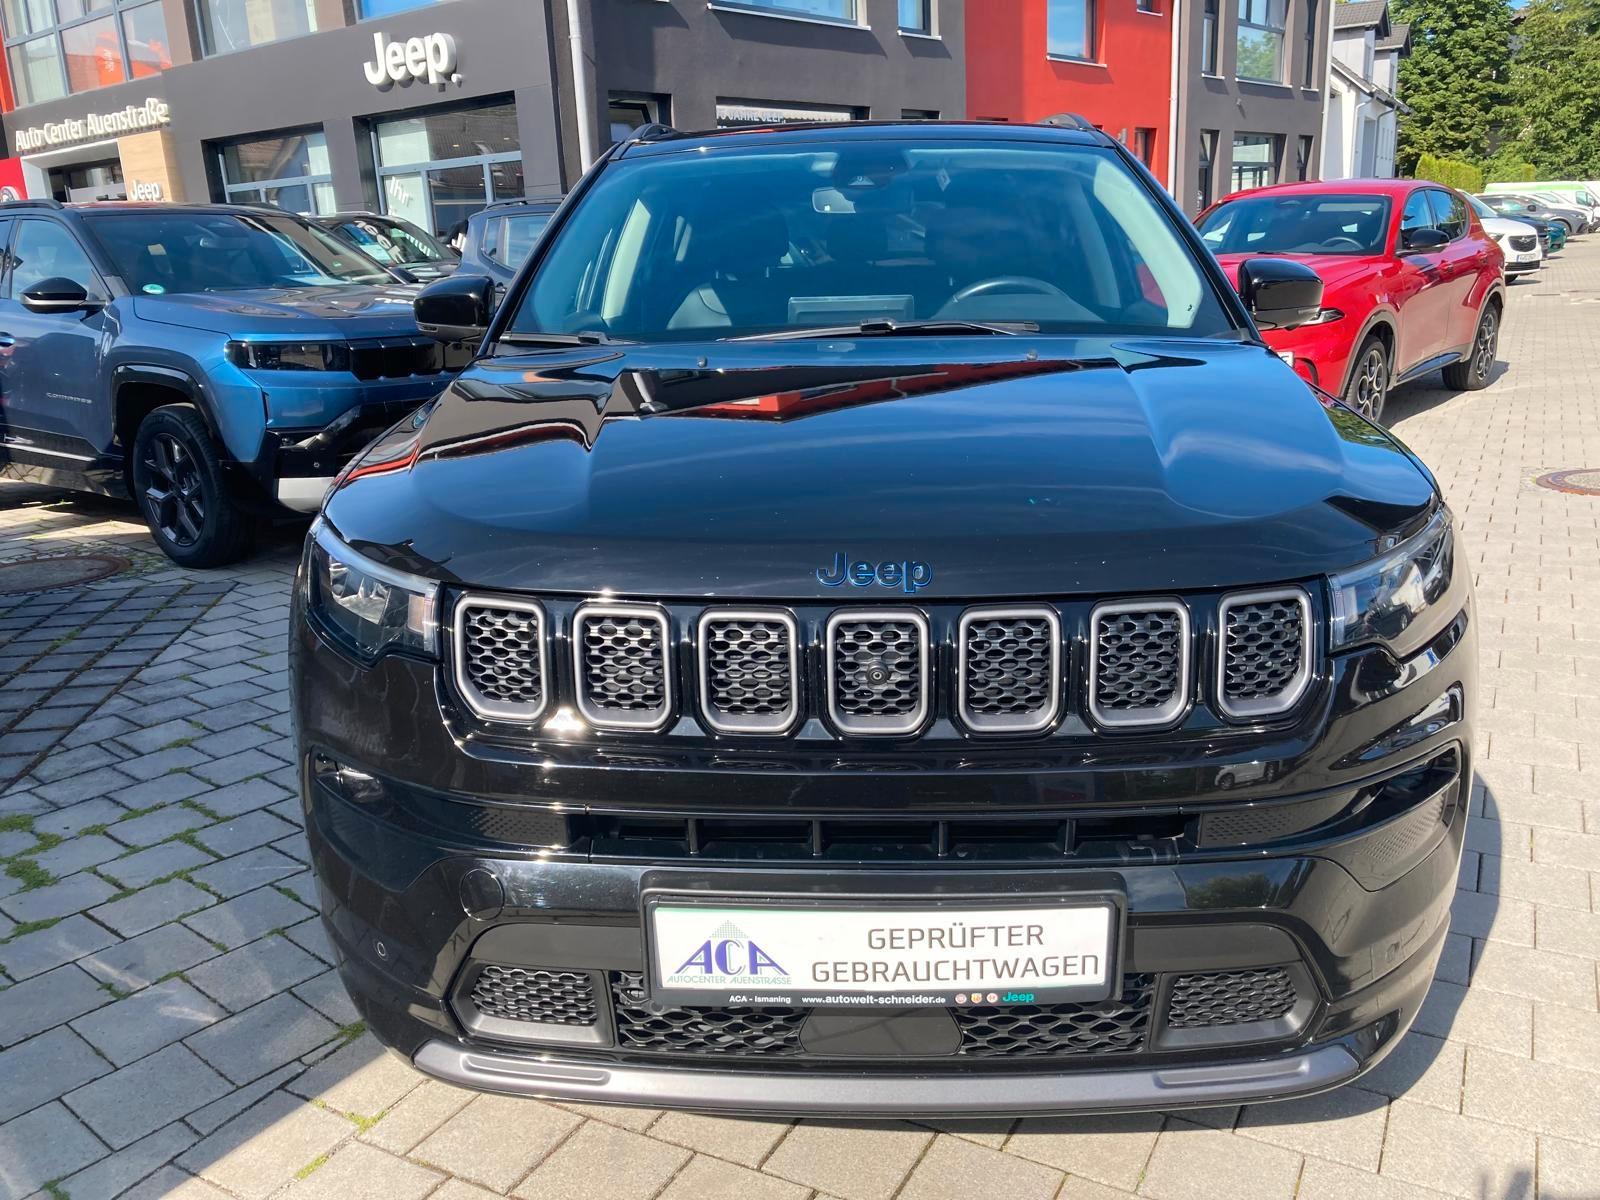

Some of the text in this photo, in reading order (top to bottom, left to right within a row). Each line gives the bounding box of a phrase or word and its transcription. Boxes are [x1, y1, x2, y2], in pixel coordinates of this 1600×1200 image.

[363, 31, 457, 85] Jeep
[15, 97, 170, 151] Auto Center Auenstraße
[130, 179, 160, 201] Jeep
[816, 552, 932, 593] Jeep
[867, 922, 1044, 950] GEPRÜFTER
[674, 939, 790, 976] ACA
[811, 954, 1099, 983] GEBRAUCHTWAGEN
[667, 975, 792, 985] AUTOCENTER AUENSTRASSE
[729, 995, 748, 1003] ACA
[754, 995, 792, 1004] Ismaning
[801, 994, 946, 1004] www.autowelt-schneider.de
[1002, 992, 1035, 1003] Jeep
